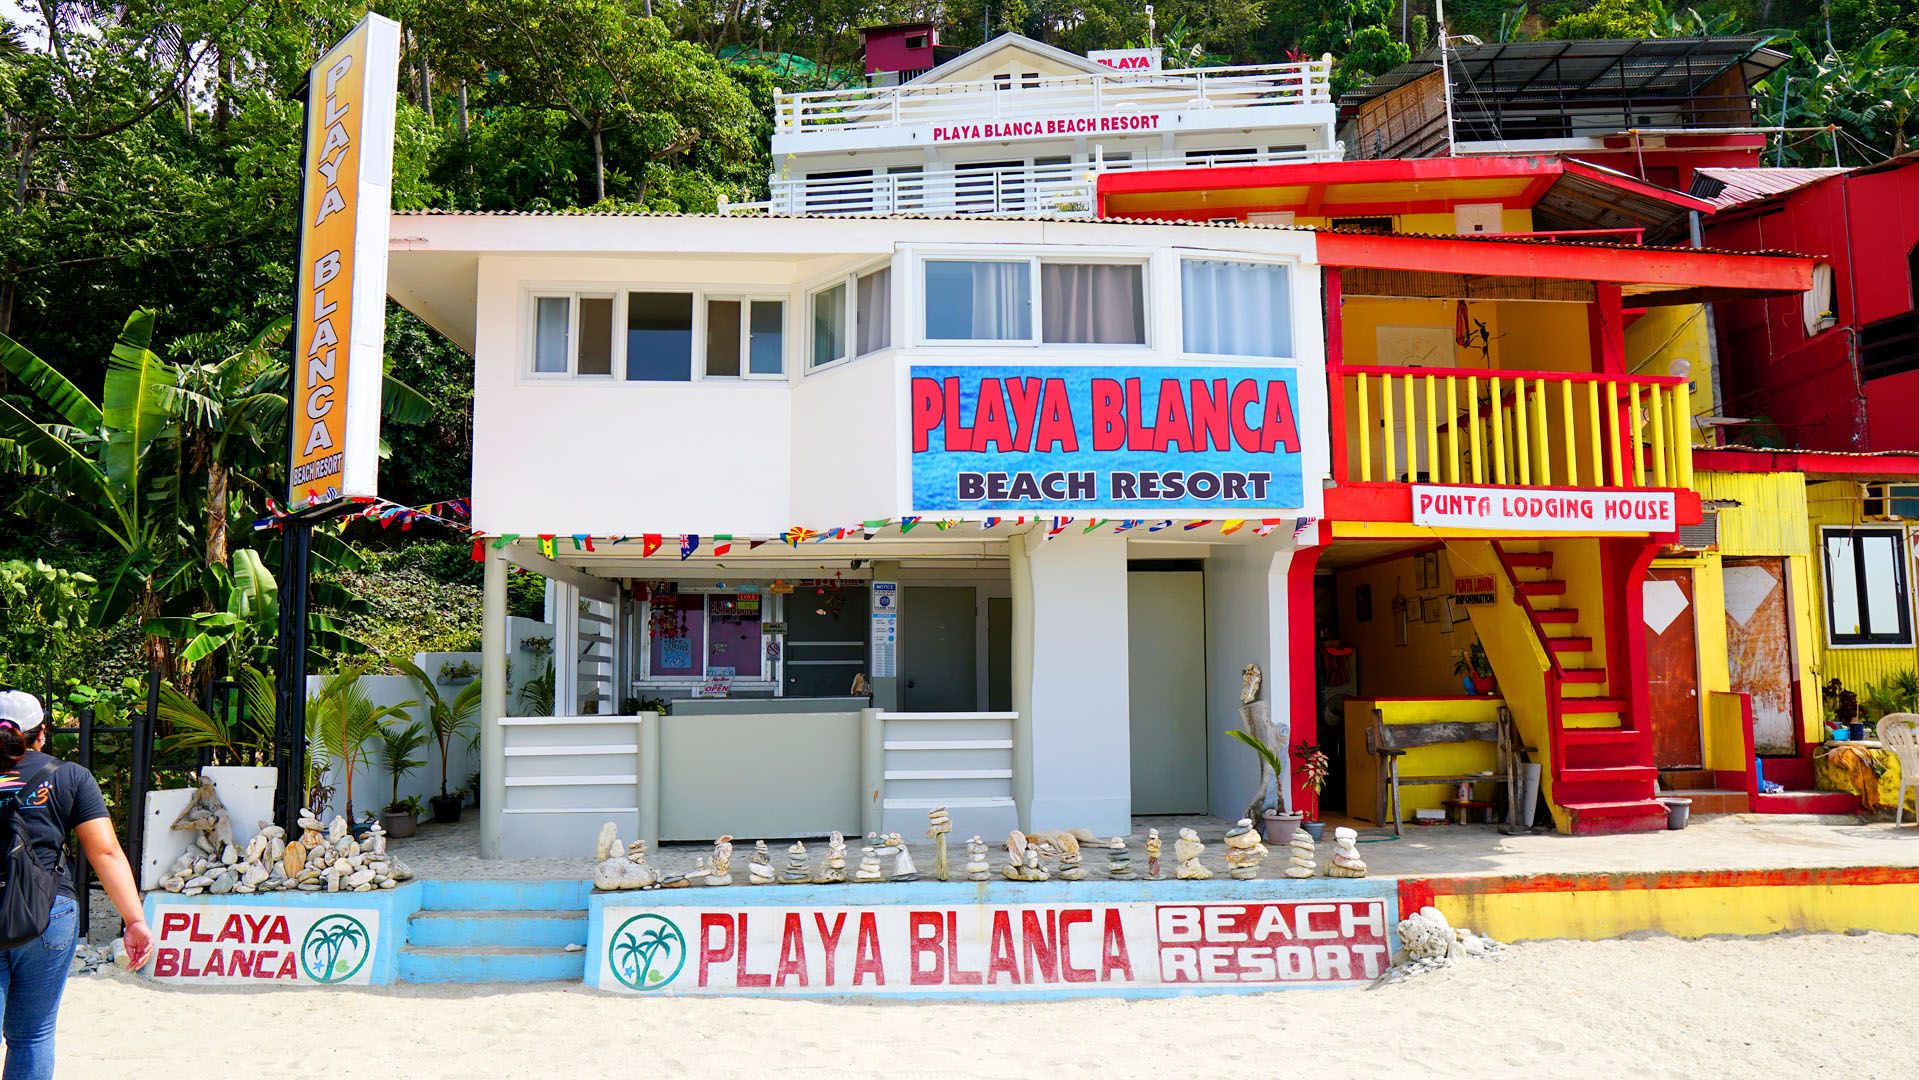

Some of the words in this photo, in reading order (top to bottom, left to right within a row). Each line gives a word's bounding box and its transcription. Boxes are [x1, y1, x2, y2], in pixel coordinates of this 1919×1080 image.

[1097, 56, 1150, 69] PLAYA
[315, 54, 353, 229] PLAYA
[933, 124, 981, 142] PLAYA
[984, 120, 1043, 138] BLANCA
[1046, 117, 1097, 135] BEACH
[1100, 114, 1160, 133] RESORT
[303, 250, 341, 458] BLANCA
[911, 376, 1079, 453] PLAYA
[1091, 377, 1302, 454] BLANCA
[293, 460, 315, 487] BEACH
[315, 452, 343, 480] RESORT
[958, 471, 1096, 502] BEACH
[1111, 471, 1271, 501] RESORT
[1419, 493, 1491, 517] PUNTA
[1502, 495, 1593, 520] LODGING
[1605, 497, 1670, 521] HOUSE
[1456, 593, 1495, 605] INFORMATION
[160, 912, 291, 944] PLAYA
[1157, 902, 1384, 943] BEACH
[154, 947, 298, 980] BLANCA
[699, 907, 885, 988] PLAYA
[910, 908, 1135, 985] BLANCA
[1160, 943, 1386, 982] RESORT
